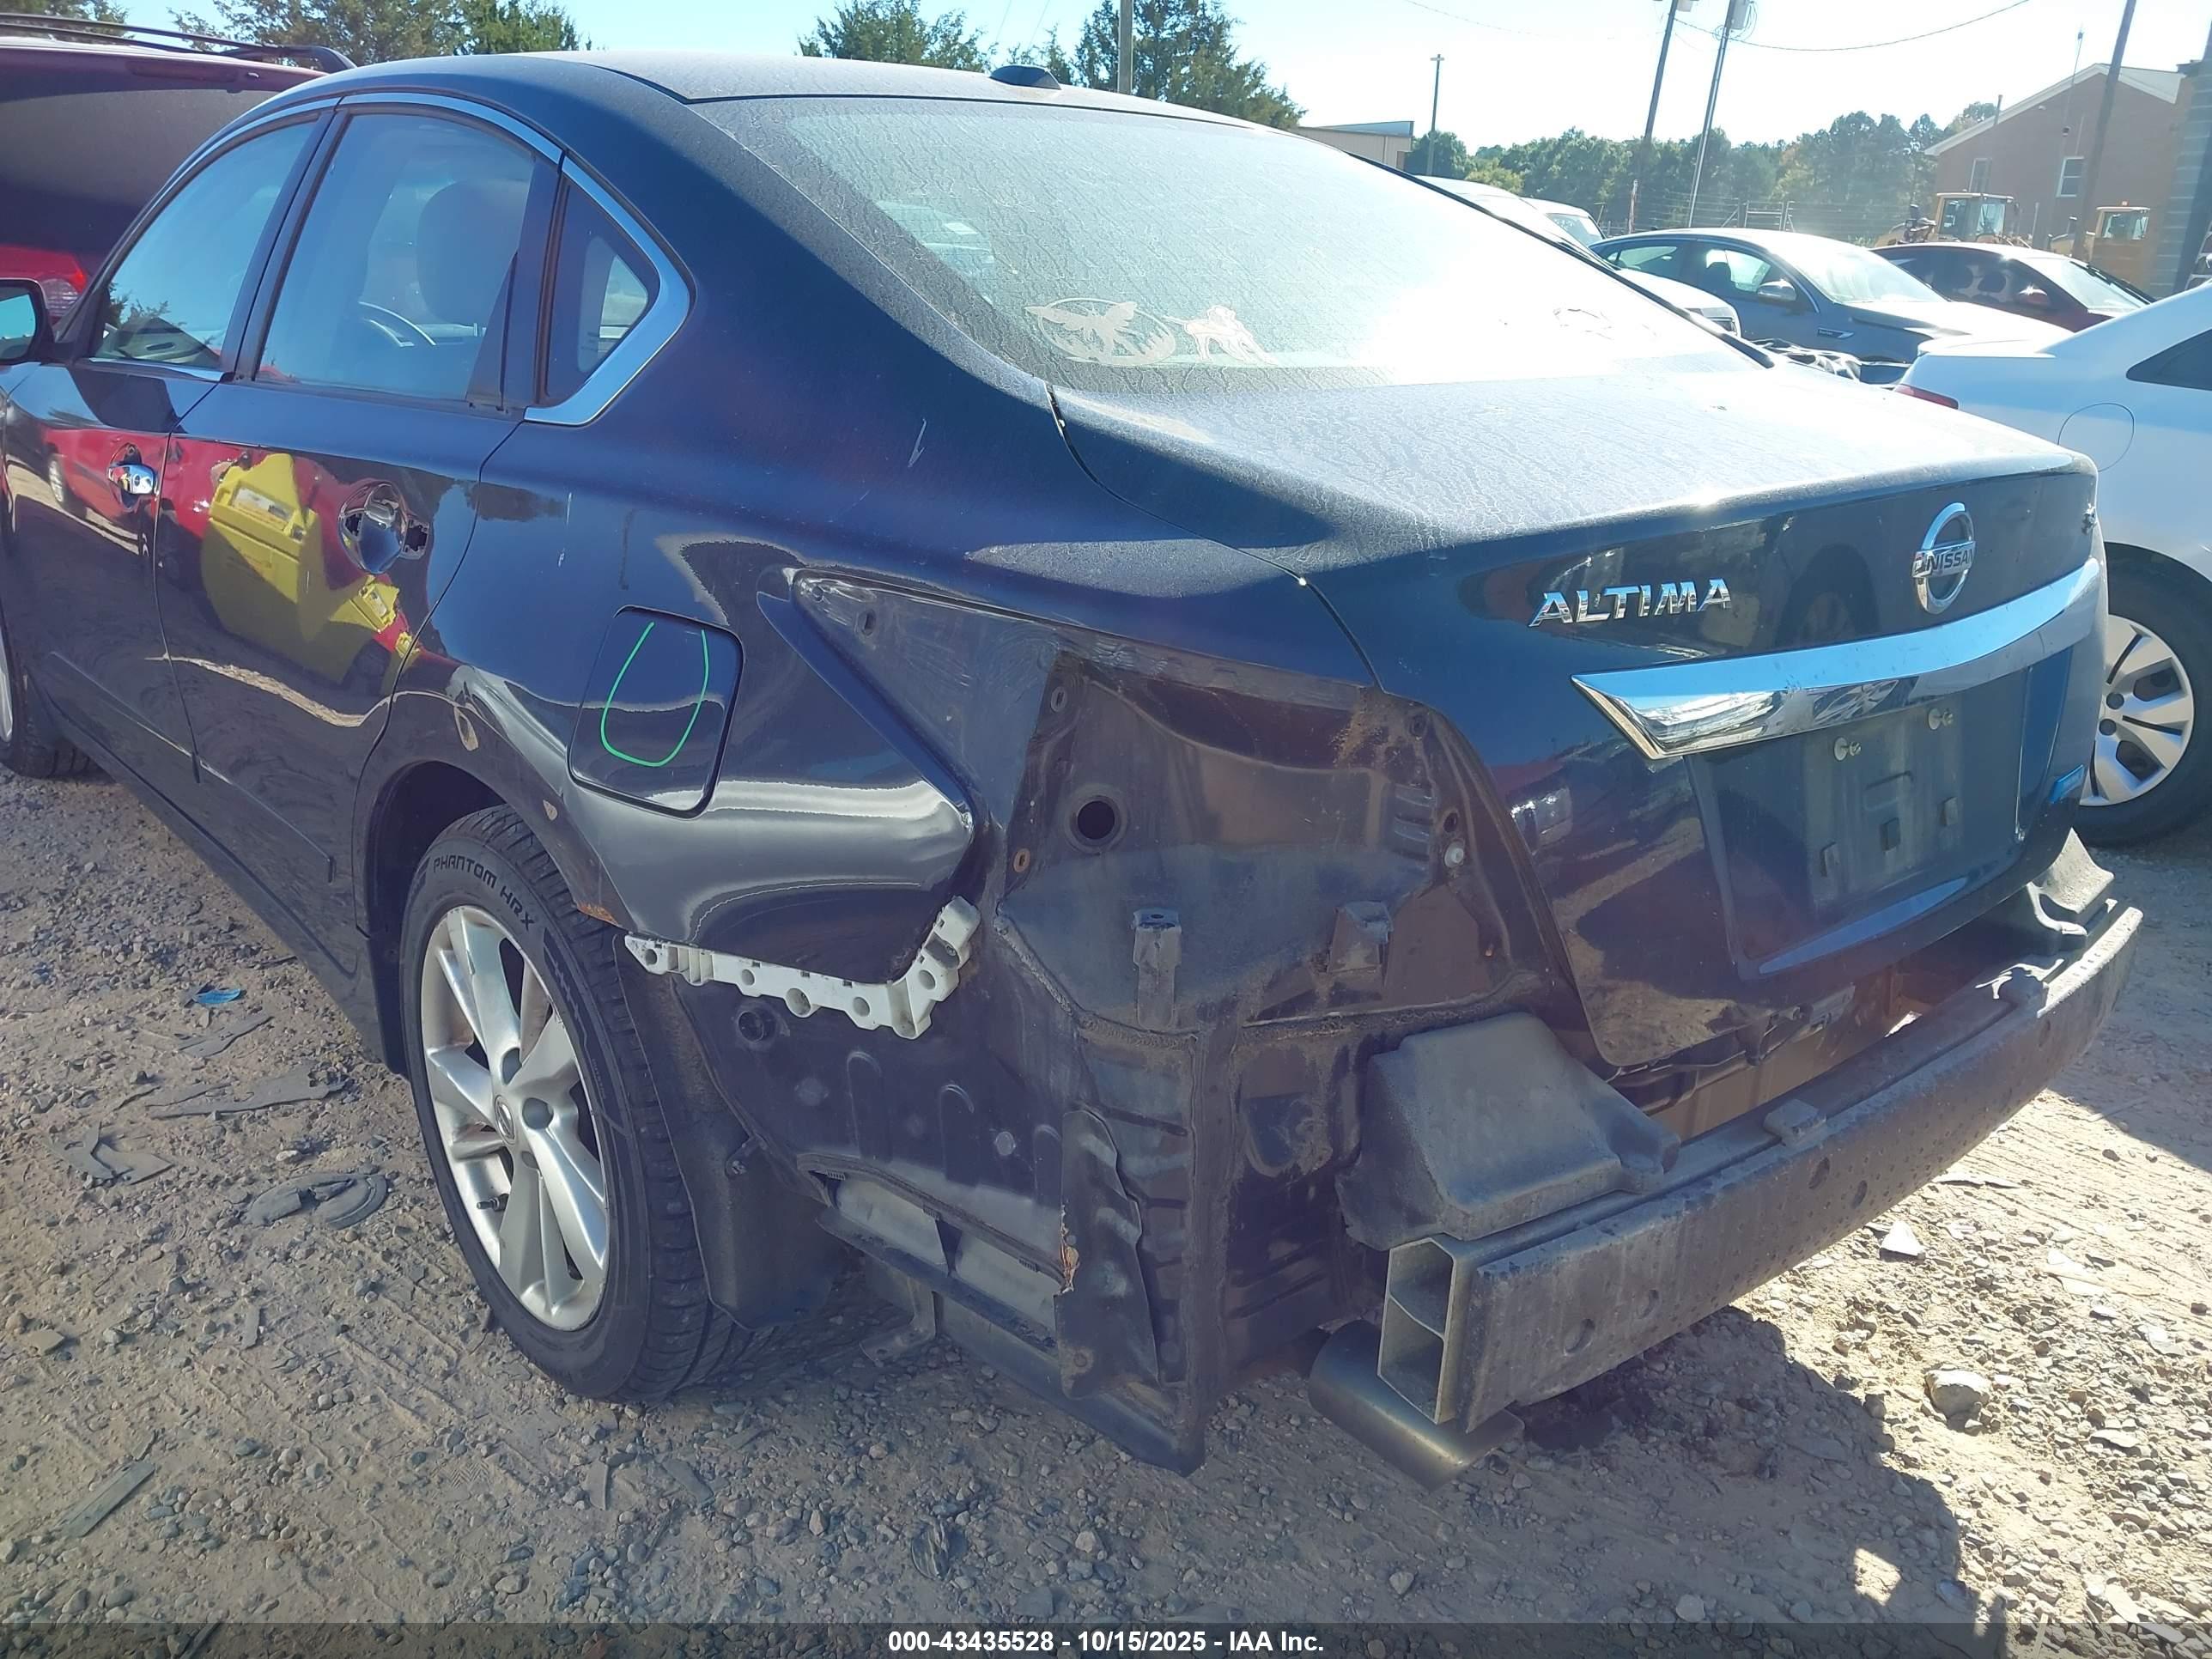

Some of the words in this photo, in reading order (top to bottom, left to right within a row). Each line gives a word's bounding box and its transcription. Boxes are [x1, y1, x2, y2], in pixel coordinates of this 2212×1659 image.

[1926, 548, 1973, 573] NISSAN
[1528, 577, 1732, 628] ALTIMA
[433, 854, 497, 889] PHANTOM
[500, 885, 535, 931] HRX
